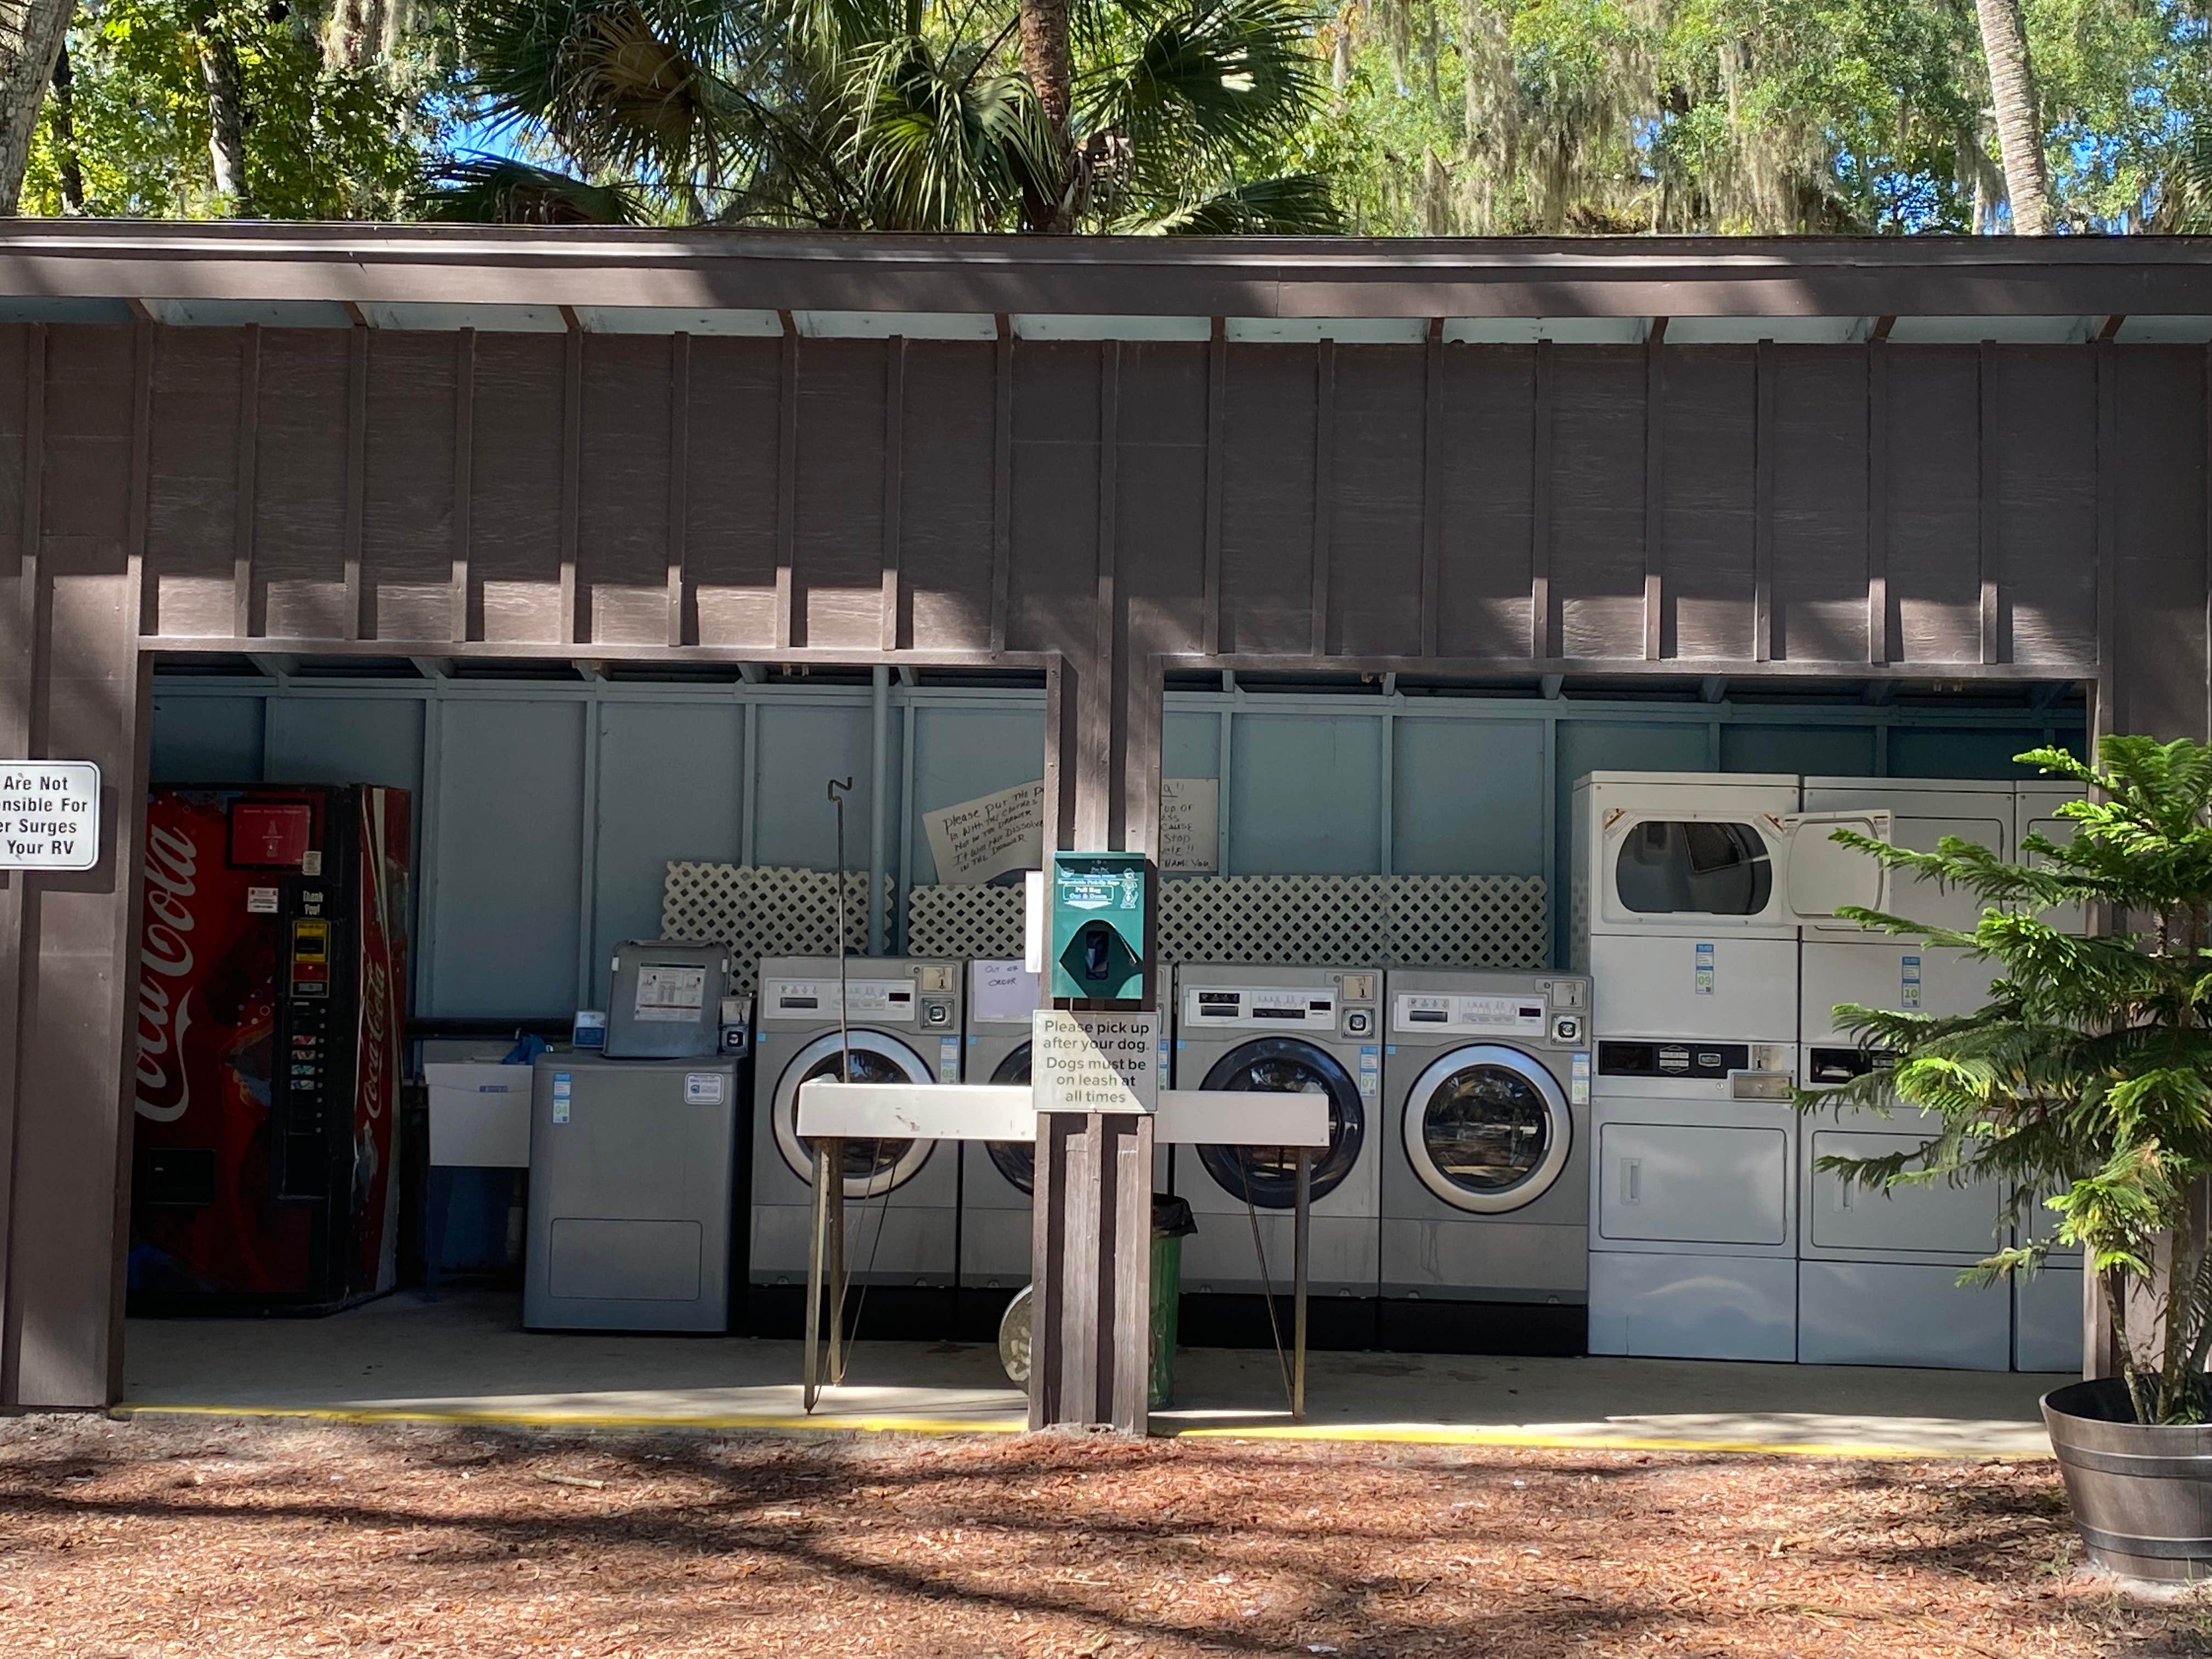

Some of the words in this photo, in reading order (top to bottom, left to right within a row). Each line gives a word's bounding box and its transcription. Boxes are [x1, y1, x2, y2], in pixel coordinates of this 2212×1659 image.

[3, 775, 32, 791] Are
[40, 776, 68, 791] Not
[0, 797, 53, 812] nsible
[61, 797, 88, 812] For
[19, 818, 77, 837] Surges
[7, 839, 44, 855] Your
[52, 840, 75, 855] RV
[1698, 975, 1712, 986] 09
[1905, 989, 1918, 998] 10
[1045, 1020, 1093, 1033] Please
[1097, 1021, 1127, 1036] pick
[1131, 1024, 1149, 1036] up
[1043, 1036, 1076, 1049] after
[1081, 1040, 1114, 1052] your
[1118, 1038, 1150, 1053] dog.
[1047, 1057, 1085, 1071] Dogs
[1088, 1058, 1125, 1070] must
[1128, 1058, 1147, 1070] be
[1057, 1076, 1075, 1085] on
[1079, 1074, 1118, 1086] leash
[1121, 1075, 1136, 1086] at
[1362, 1077, 1375, 1088] 07
[1065, 1090, 1082, 1102] all
[1086, 1090, 1126, 1103] times
